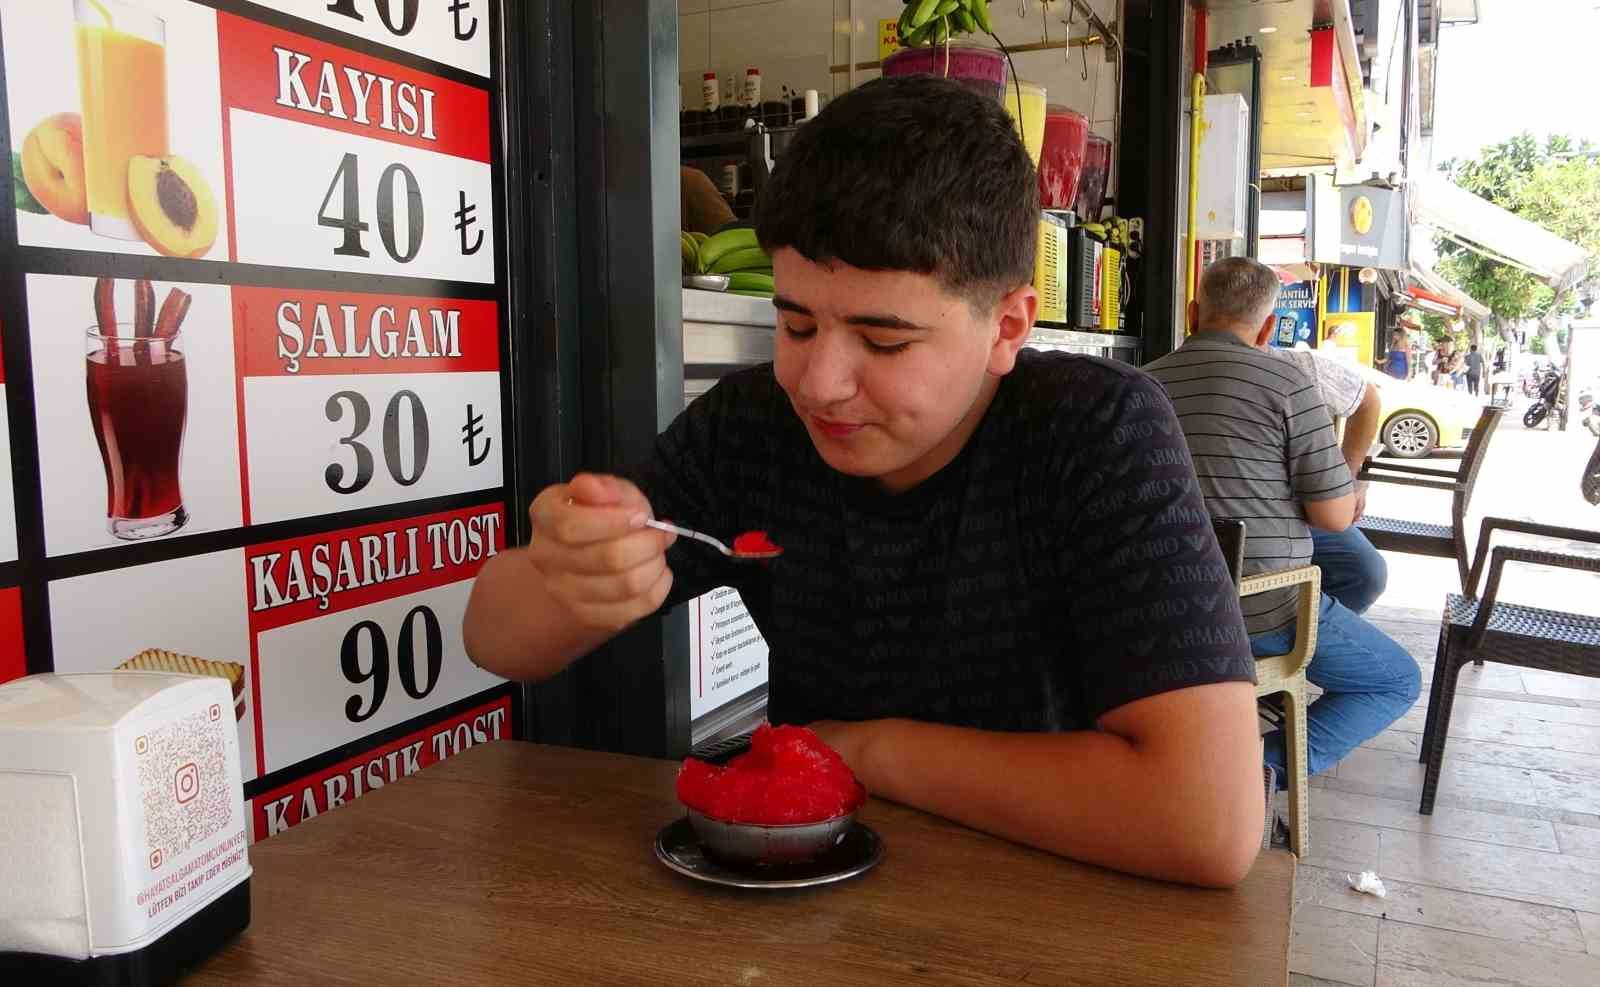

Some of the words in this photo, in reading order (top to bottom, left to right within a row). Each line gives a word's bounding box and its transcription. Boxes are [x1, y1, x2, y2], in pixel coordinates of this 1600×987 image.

[272, 46, 438, 141] KAYISI
[317, 152, 426, 264] 40
[454, 190, 485, 256] ₺
[276, 302, 463, 373] ŞALGAM
[324, 389, 430, 494] 30
[461, 403, 492, 467] ₺
[250, 526, 421, 610] KAŞARLI
[427, 512, 501, 571] TOST
[340, 604, 443, 723] 90
[432, 706, 506, 761] TOST
